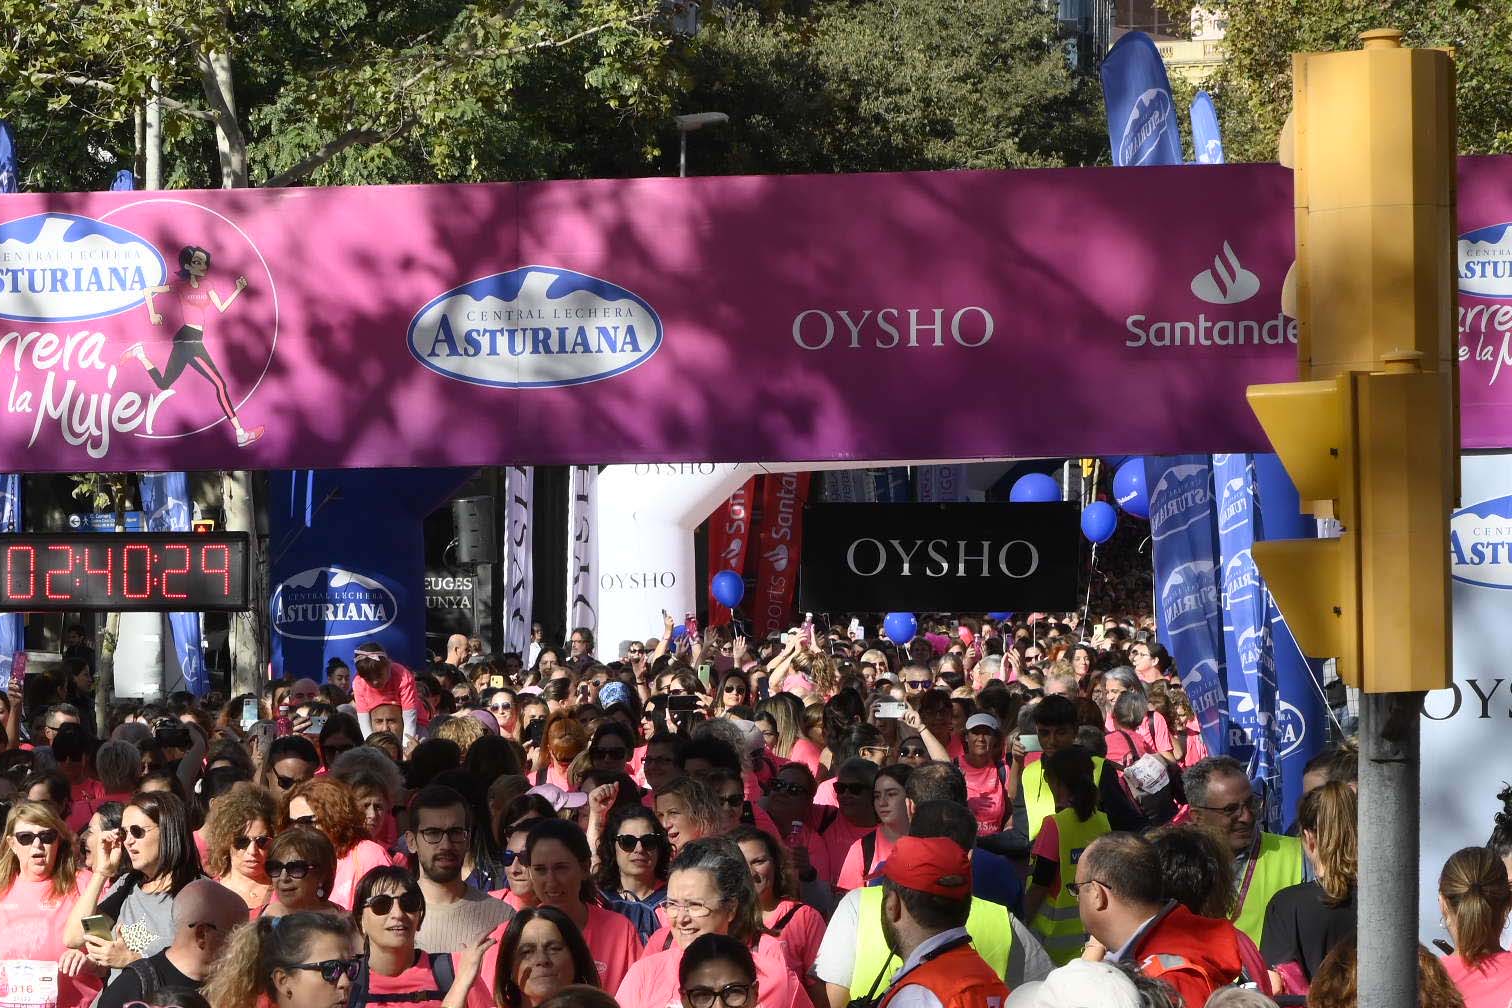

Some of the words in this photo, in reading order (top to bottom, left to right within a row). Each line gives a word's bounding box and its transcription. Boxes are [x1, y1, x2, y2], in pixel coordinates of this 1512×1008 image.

[1466, 248, 1512, 257] CENTRA
[467, 308, 546, 321] CENTRAL
[553, 307, 635, 319] LECHERA
[792, 305, 994, 351] OYSHO
[1125, 312, 1299, 348] Santande
[428, 311, 643, 358] ASTURIANA
[1458, 344, 1470, 361] e
[1476, 335, 1493, 361] la
[1489, 331, 1512, 387] M
[8, 373, 33, 413] la
[28, 366, 176, 459] Mujer
[1472, 526, 1512, 537] CENT
[6, 545, 230, 601] 02:40:29
[846, 537, 1039, 579] OYSHO
[600, 571, 676, 591] OYSHO
[276, 596, 388, 624] ASTURIANA
